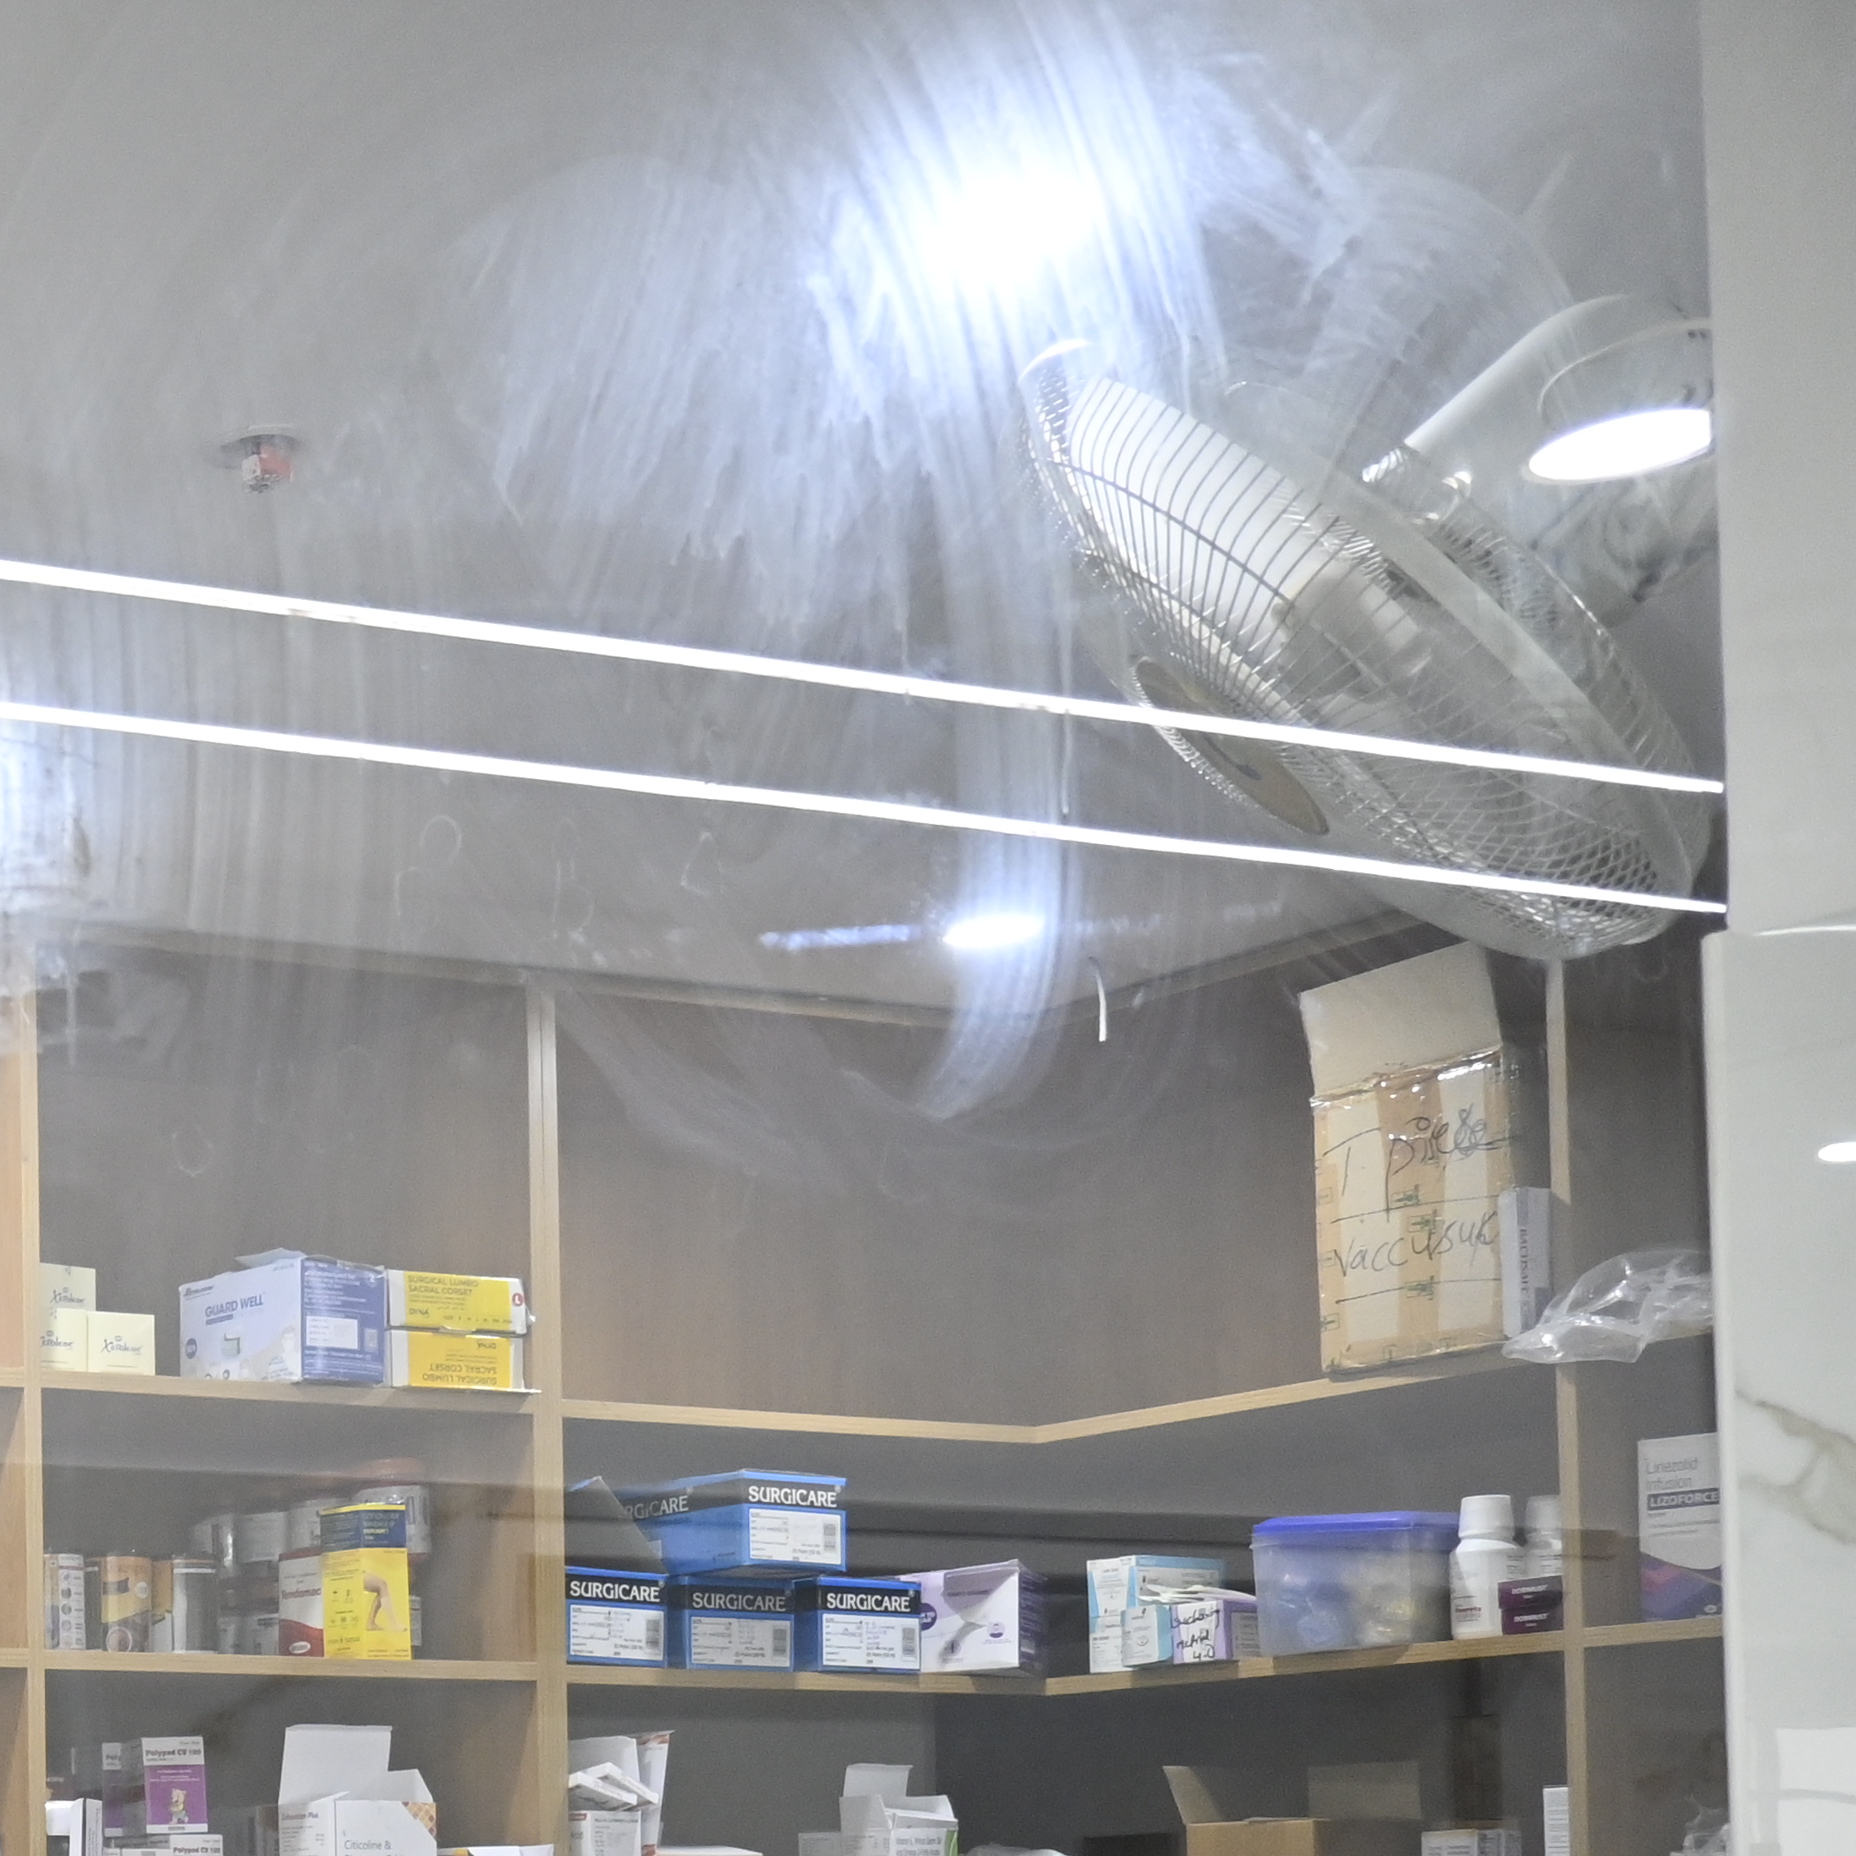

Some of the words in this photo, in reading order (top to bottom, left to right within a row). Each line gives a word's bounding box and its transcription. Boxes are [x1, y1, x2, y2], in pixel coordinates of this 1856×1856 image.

[408, 1276, 447, 1286] SURGICAL
[449, 1277, 478, 1287] LUMBO
[408, 1285, 442, 1295] SACRAL
[444, 1286, 472, 1296] CORSET
[205, 1300, 238, 1318] GUARD
[240, 1295, 264, 1310] WELL
[514, 1295, 522, 1305] L
[427, 1363, 464, 1373] CORSET
[467, 1365, 498, 1374] SACRAL
[422, 1373, 459, 1383] LUMBO
[460, 1375, 498, 1385] SURGICAL
[1645, 1458, 1698, 1475] Linezolid
[1646, 1475, 1692, 1490] Infusion
[749, 1486, 836, 1507] SURGICARE
[1649, 1491, 1719, 1507] LIZOFORCE
[570, 1581, 659, 1603] SURGICARE
[693, 1591, 785, 1612] SURGICARE
[827, 1592, 909, 1612] SURGICARE
[344, 1840, 381, 1851] Citicoline
[383, 1841, 391, 1850] &
